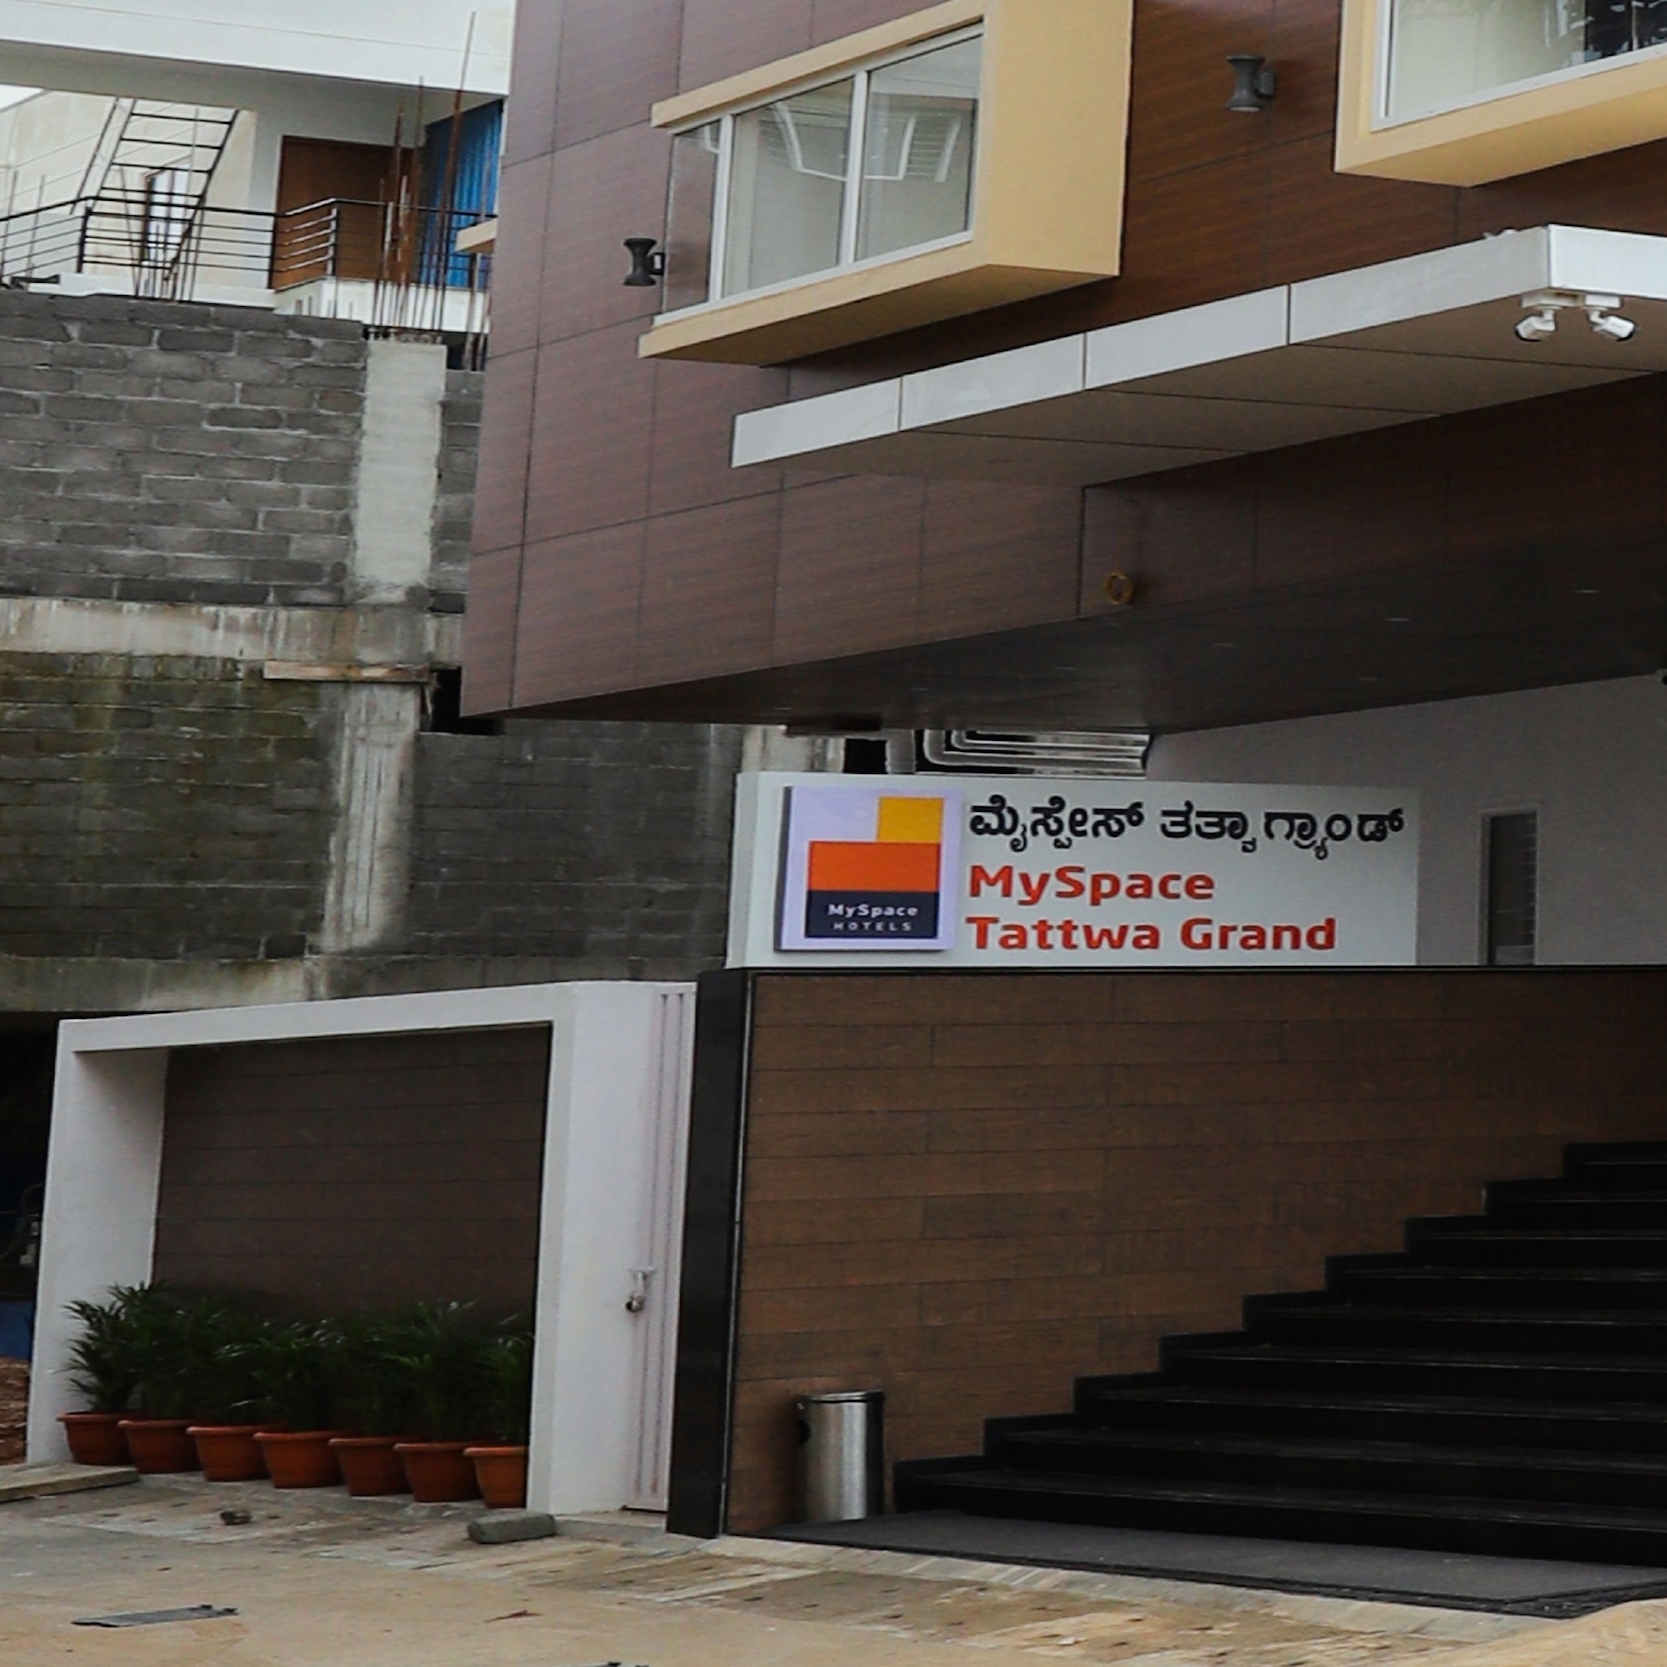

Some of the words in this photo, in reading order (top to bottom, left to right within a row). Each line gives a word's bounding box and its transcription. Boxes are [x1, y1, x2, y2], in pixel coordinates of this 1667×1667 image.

[969, 794, 1145, 853] ಮೈಸ್ಪೇಸ್
[969, 864, 1214, 906] MySpace
[828, 903, 918, 918] MySpace
[833, 921, 912, 931] HOTELS
[966, 916, 1160, 950] Tattwa
[1180, 917, 1336, 950] Grand
